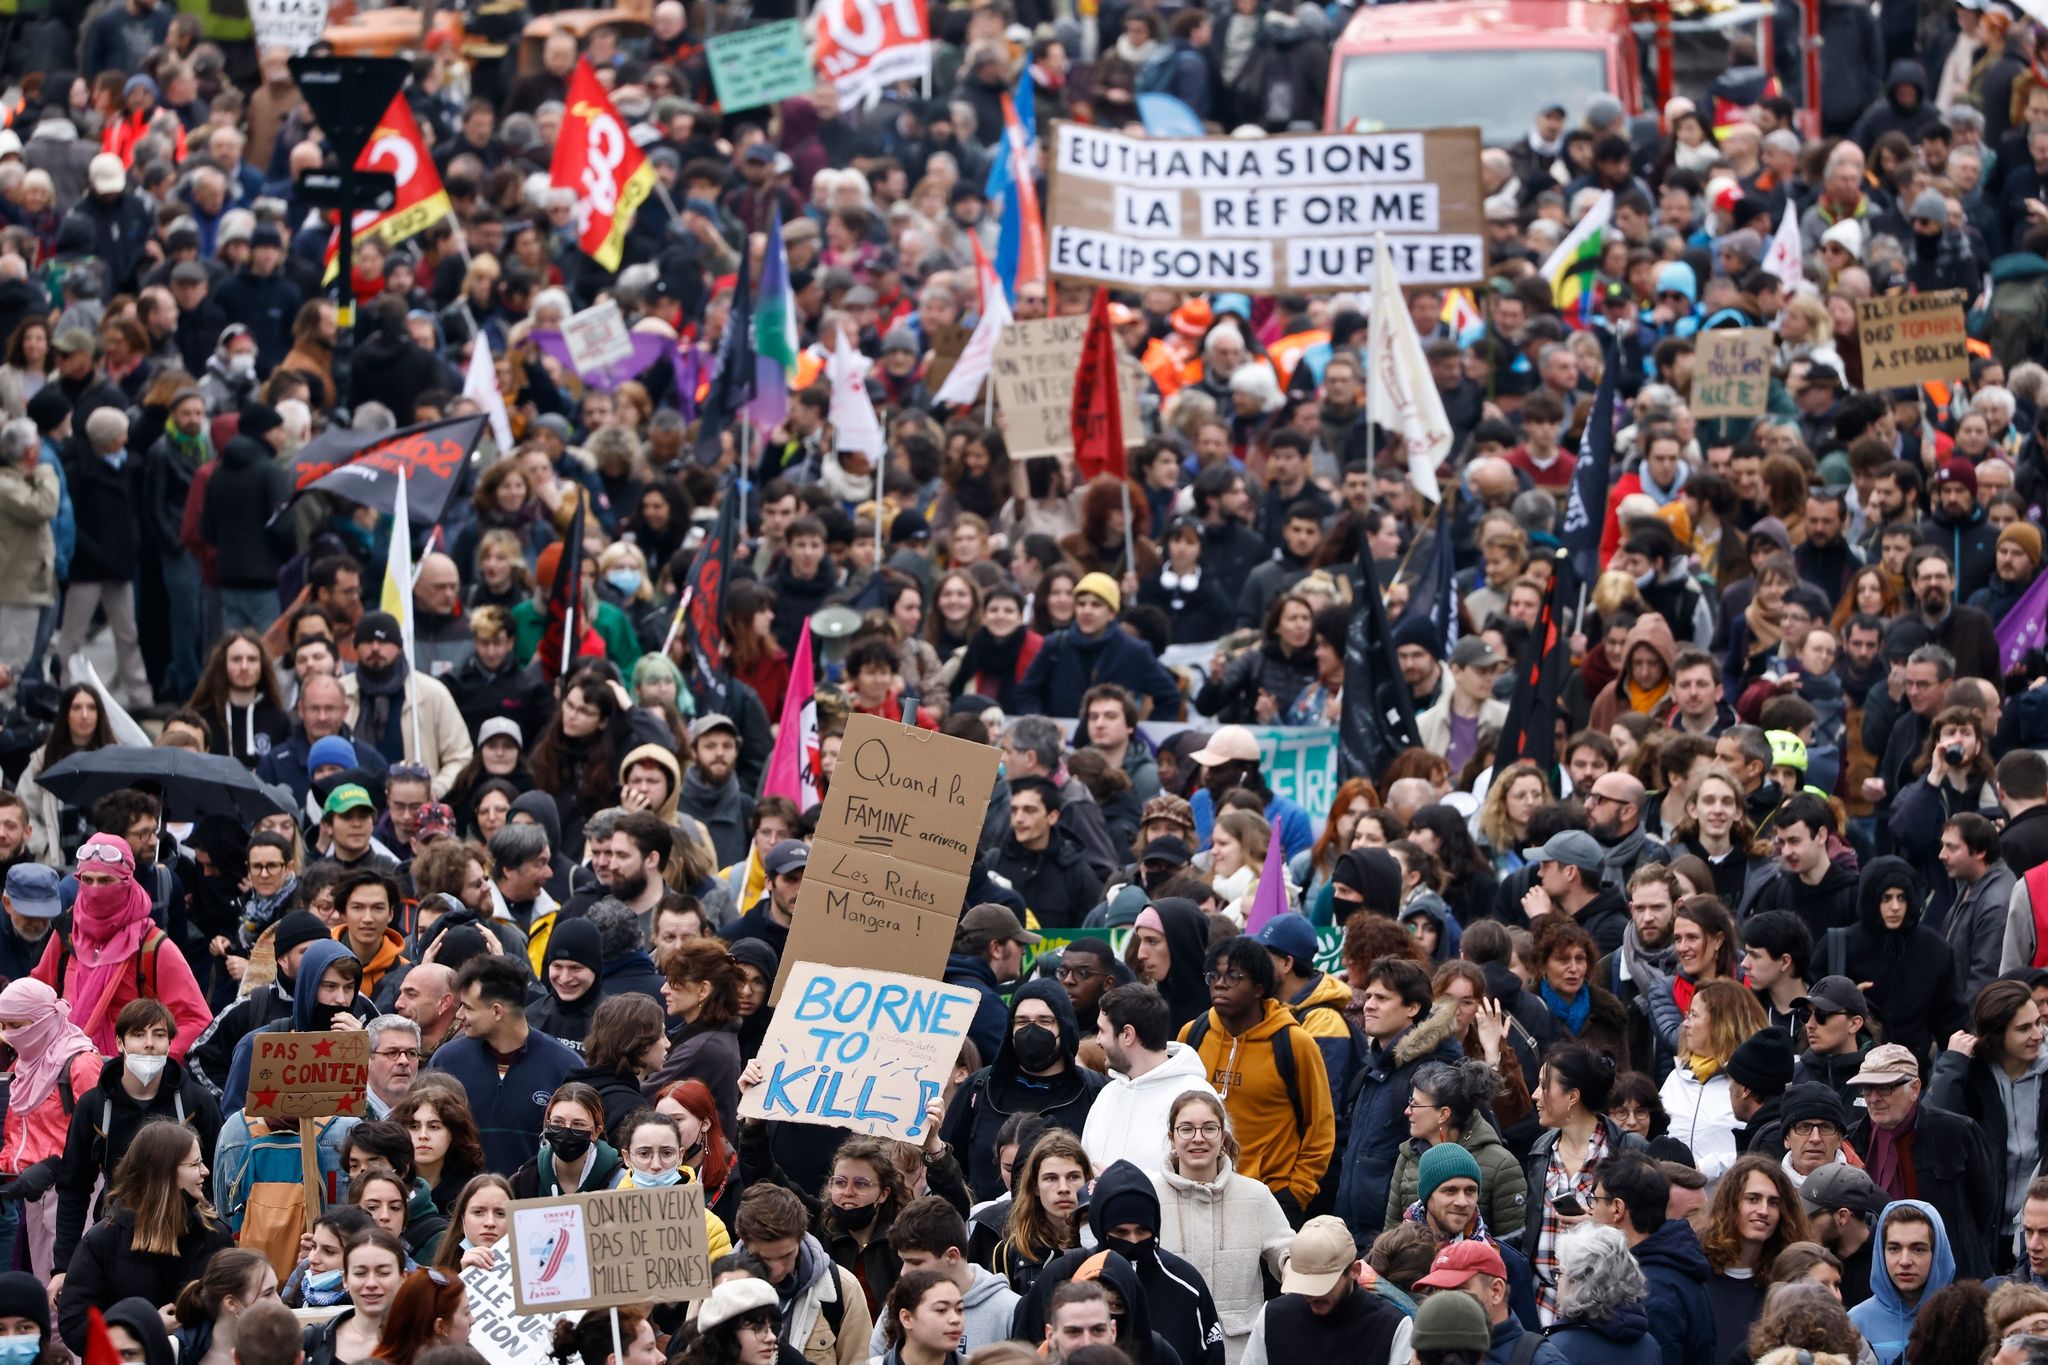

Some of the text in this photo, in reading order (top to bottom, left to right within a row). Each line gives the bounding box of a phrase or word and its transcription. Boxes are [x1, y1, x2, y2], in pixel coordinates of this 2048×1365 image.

[1071, 136, 1411, 177] EUTHANASIONS
[1127, 188, 1425, 227] LA RÉFORME
[1057, 226, 1260, 279] ÉCLIPSONS
[1863, 300, 1893, 321] ILS
[1864, 324, 1894, 346] DES
[854, 738, 937, 797] Quand
[949, 774, 965, 806] la
[844, 795, 968, 855] FAMINE arrivera
[831, 854, 935, 905] Les Riches
[826, 889, 900, 933] Mangera
[861, 891, 885, 910] On
[794, 976, 974, 1038] BORNE
[261, 1041, 299, 1061] PAS
[808, 1026, 871, 1064] TO
[586, 1190, 699, 1227] ON N'EN VEUX
[589, 1226, 692, 1261] PAS DE TON
[463, 1267, 512, 1309] ELLE
[592, 1261, 638, 1297] MILLE
